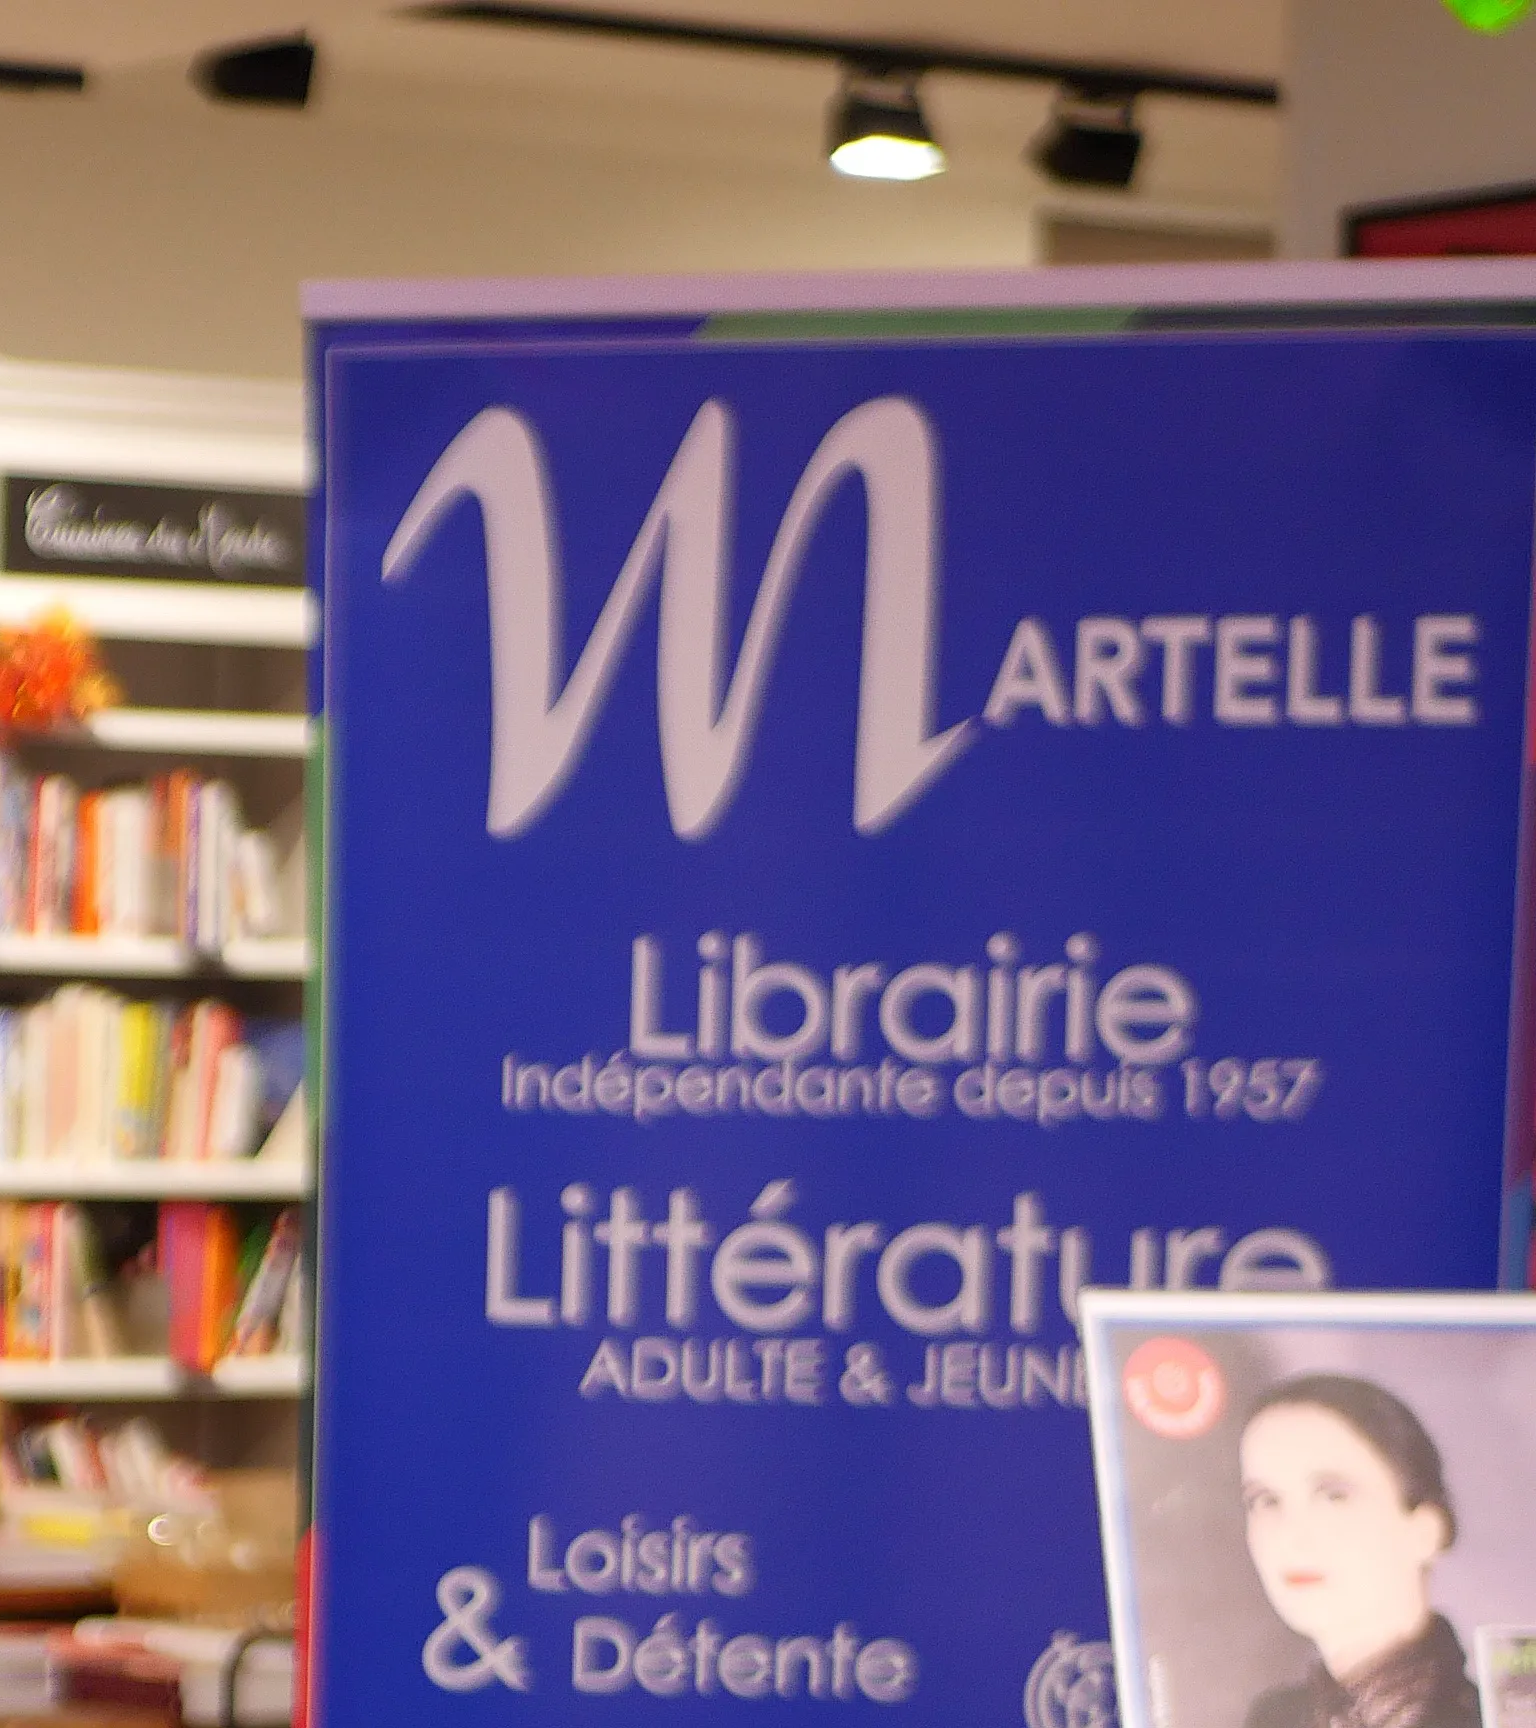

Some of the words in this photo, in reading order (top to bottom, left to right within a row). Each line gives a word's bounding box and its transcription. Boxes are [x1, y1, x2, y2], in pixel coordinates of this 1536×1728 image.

[629, 930, 1199, 1063] Librairie
[501, 1050, 936, 1124] Indépendante
[953, 1052, 1160, 1127] depuis
[1181, 1055, 1319, 1122] 1957
[485, 1177, 1327, 1331] Littérature
[579, 1338, 821, 1402] ADULTE
[839, 1341, 892, 1404] &
[906, 1341, 1088, 1407] JEUN
[423, 1566, 530, 1693] &
[528, 1512, 751, 1597] Loisirs
[571, 1613, 919, 1703] Détente
